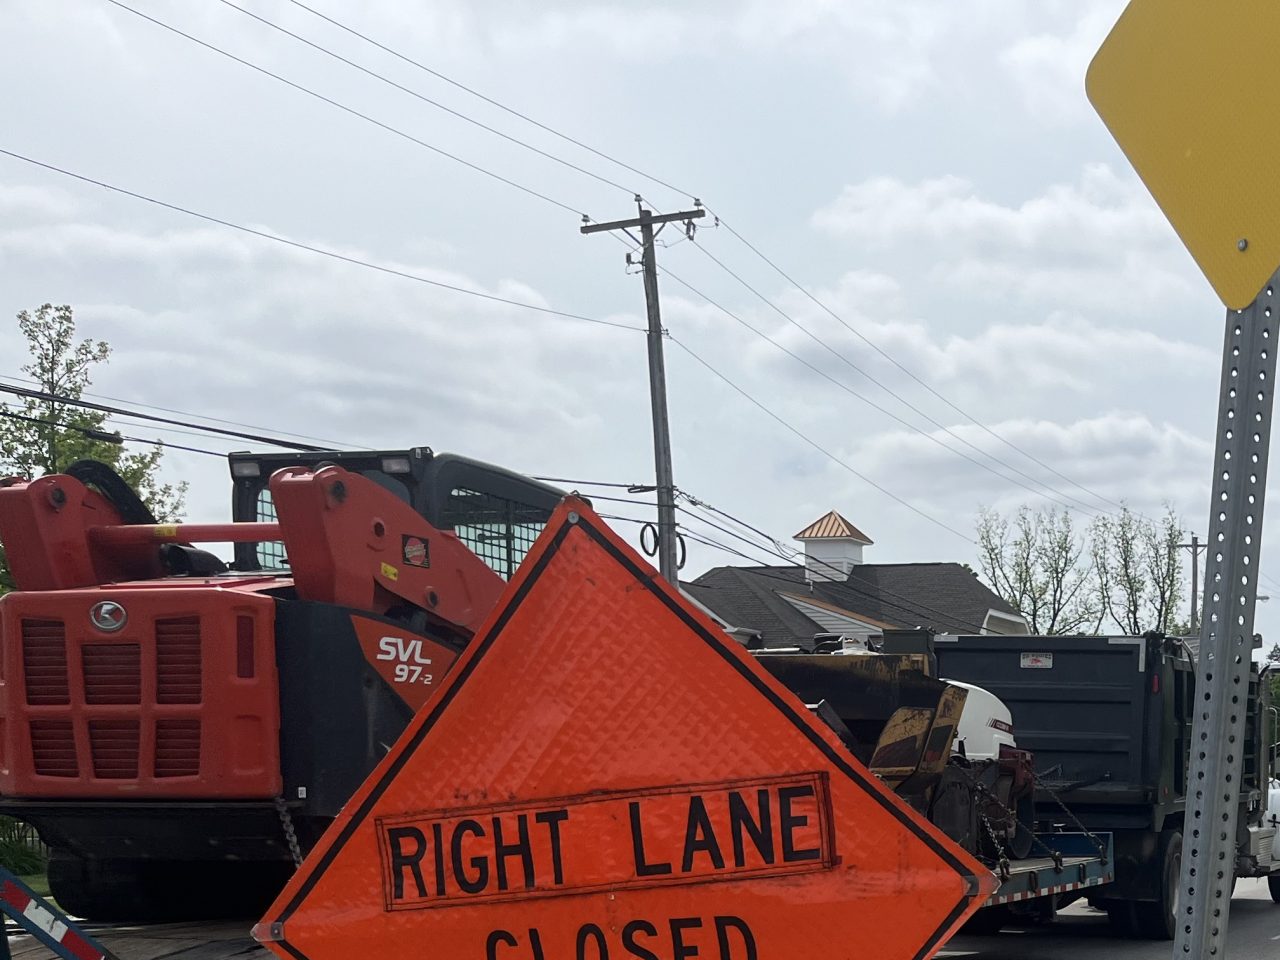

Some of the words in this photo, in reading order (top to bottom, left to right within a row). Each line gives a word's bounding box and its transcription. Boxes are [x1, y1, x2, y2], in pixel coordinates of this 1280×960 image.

[376, 636, 432, 665] SVL
[394, 664, 433, 685] 97-2
[386, 810, 569, 899] RIGHT
[628, 784, 822, 877] LANE
